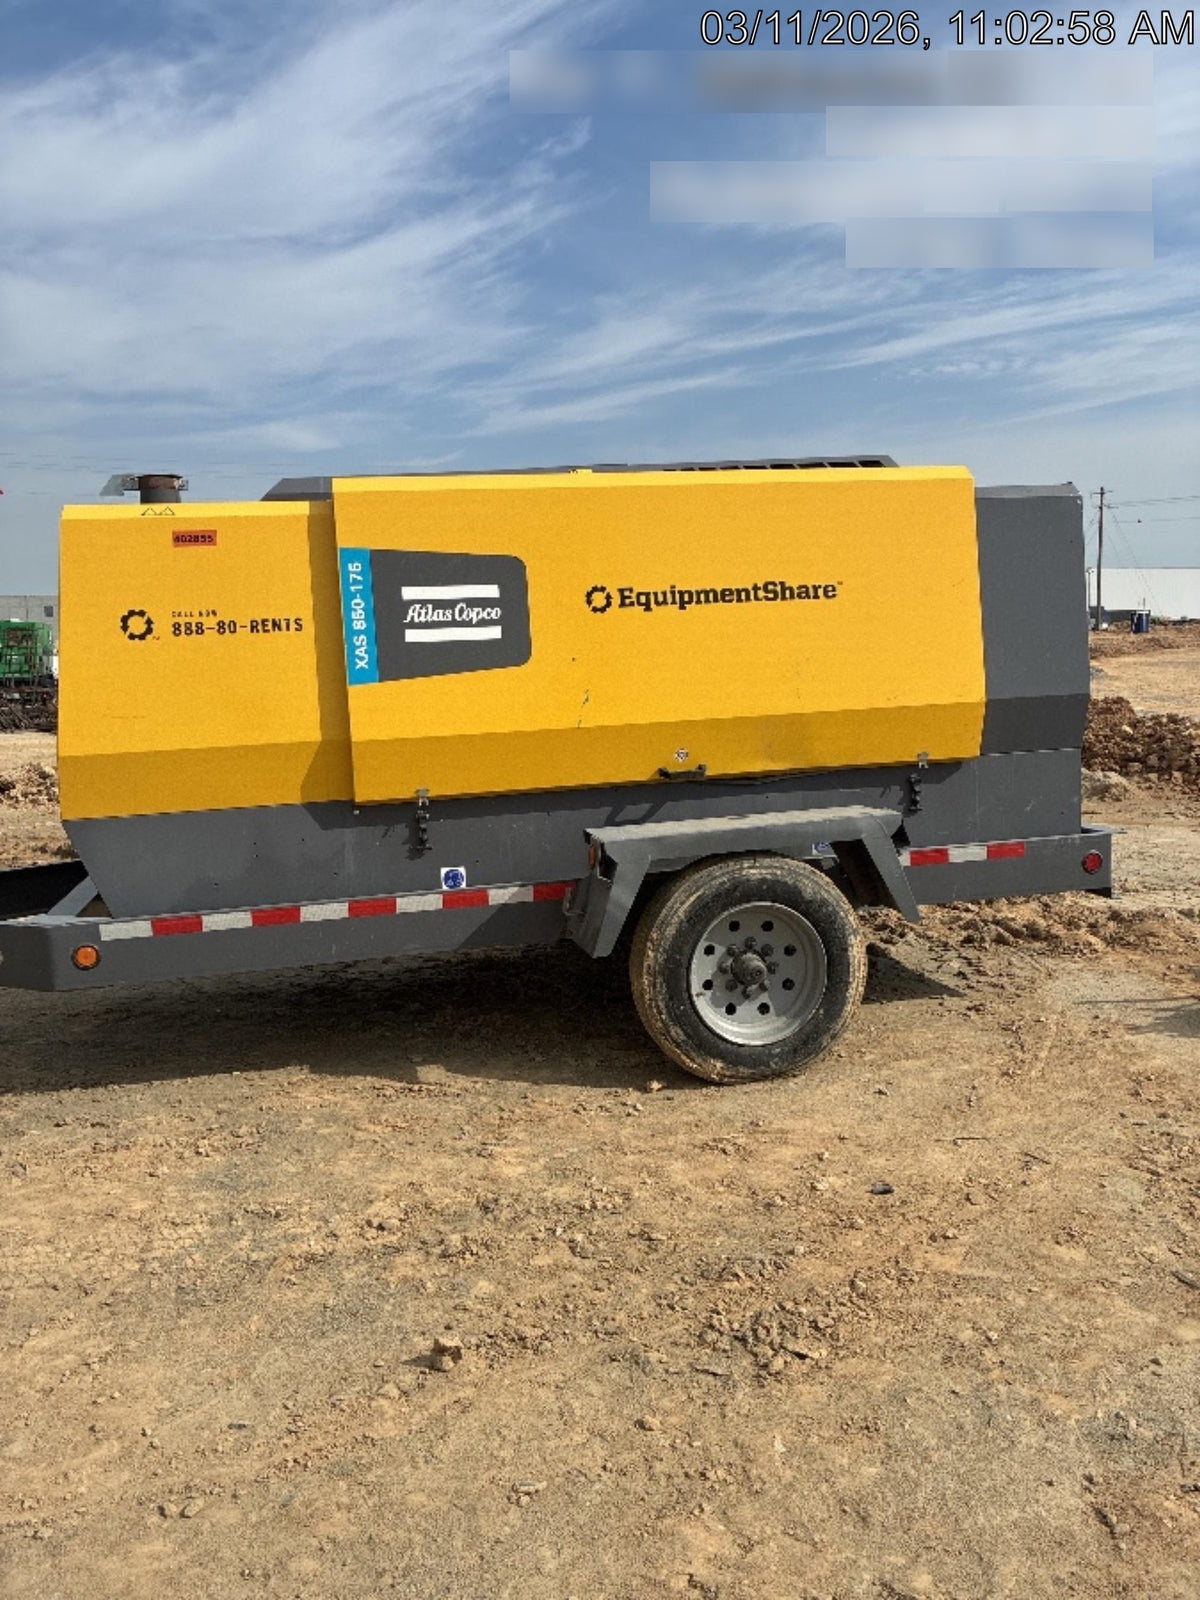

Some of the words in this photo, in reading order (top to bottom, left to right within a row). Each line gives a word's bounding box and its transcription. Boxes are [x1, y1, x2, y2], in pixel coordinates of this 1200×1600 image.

[348, 562, 367, 630] 850-175
[617, 581, 838, 612] EquipmentShare
[172, 618, 303, 637] 888-80-RENTS
[403, 603, 453, 623] Atlas
[454, 602, 502, 625] Copco
[355, 634, 369, 669] XAS
